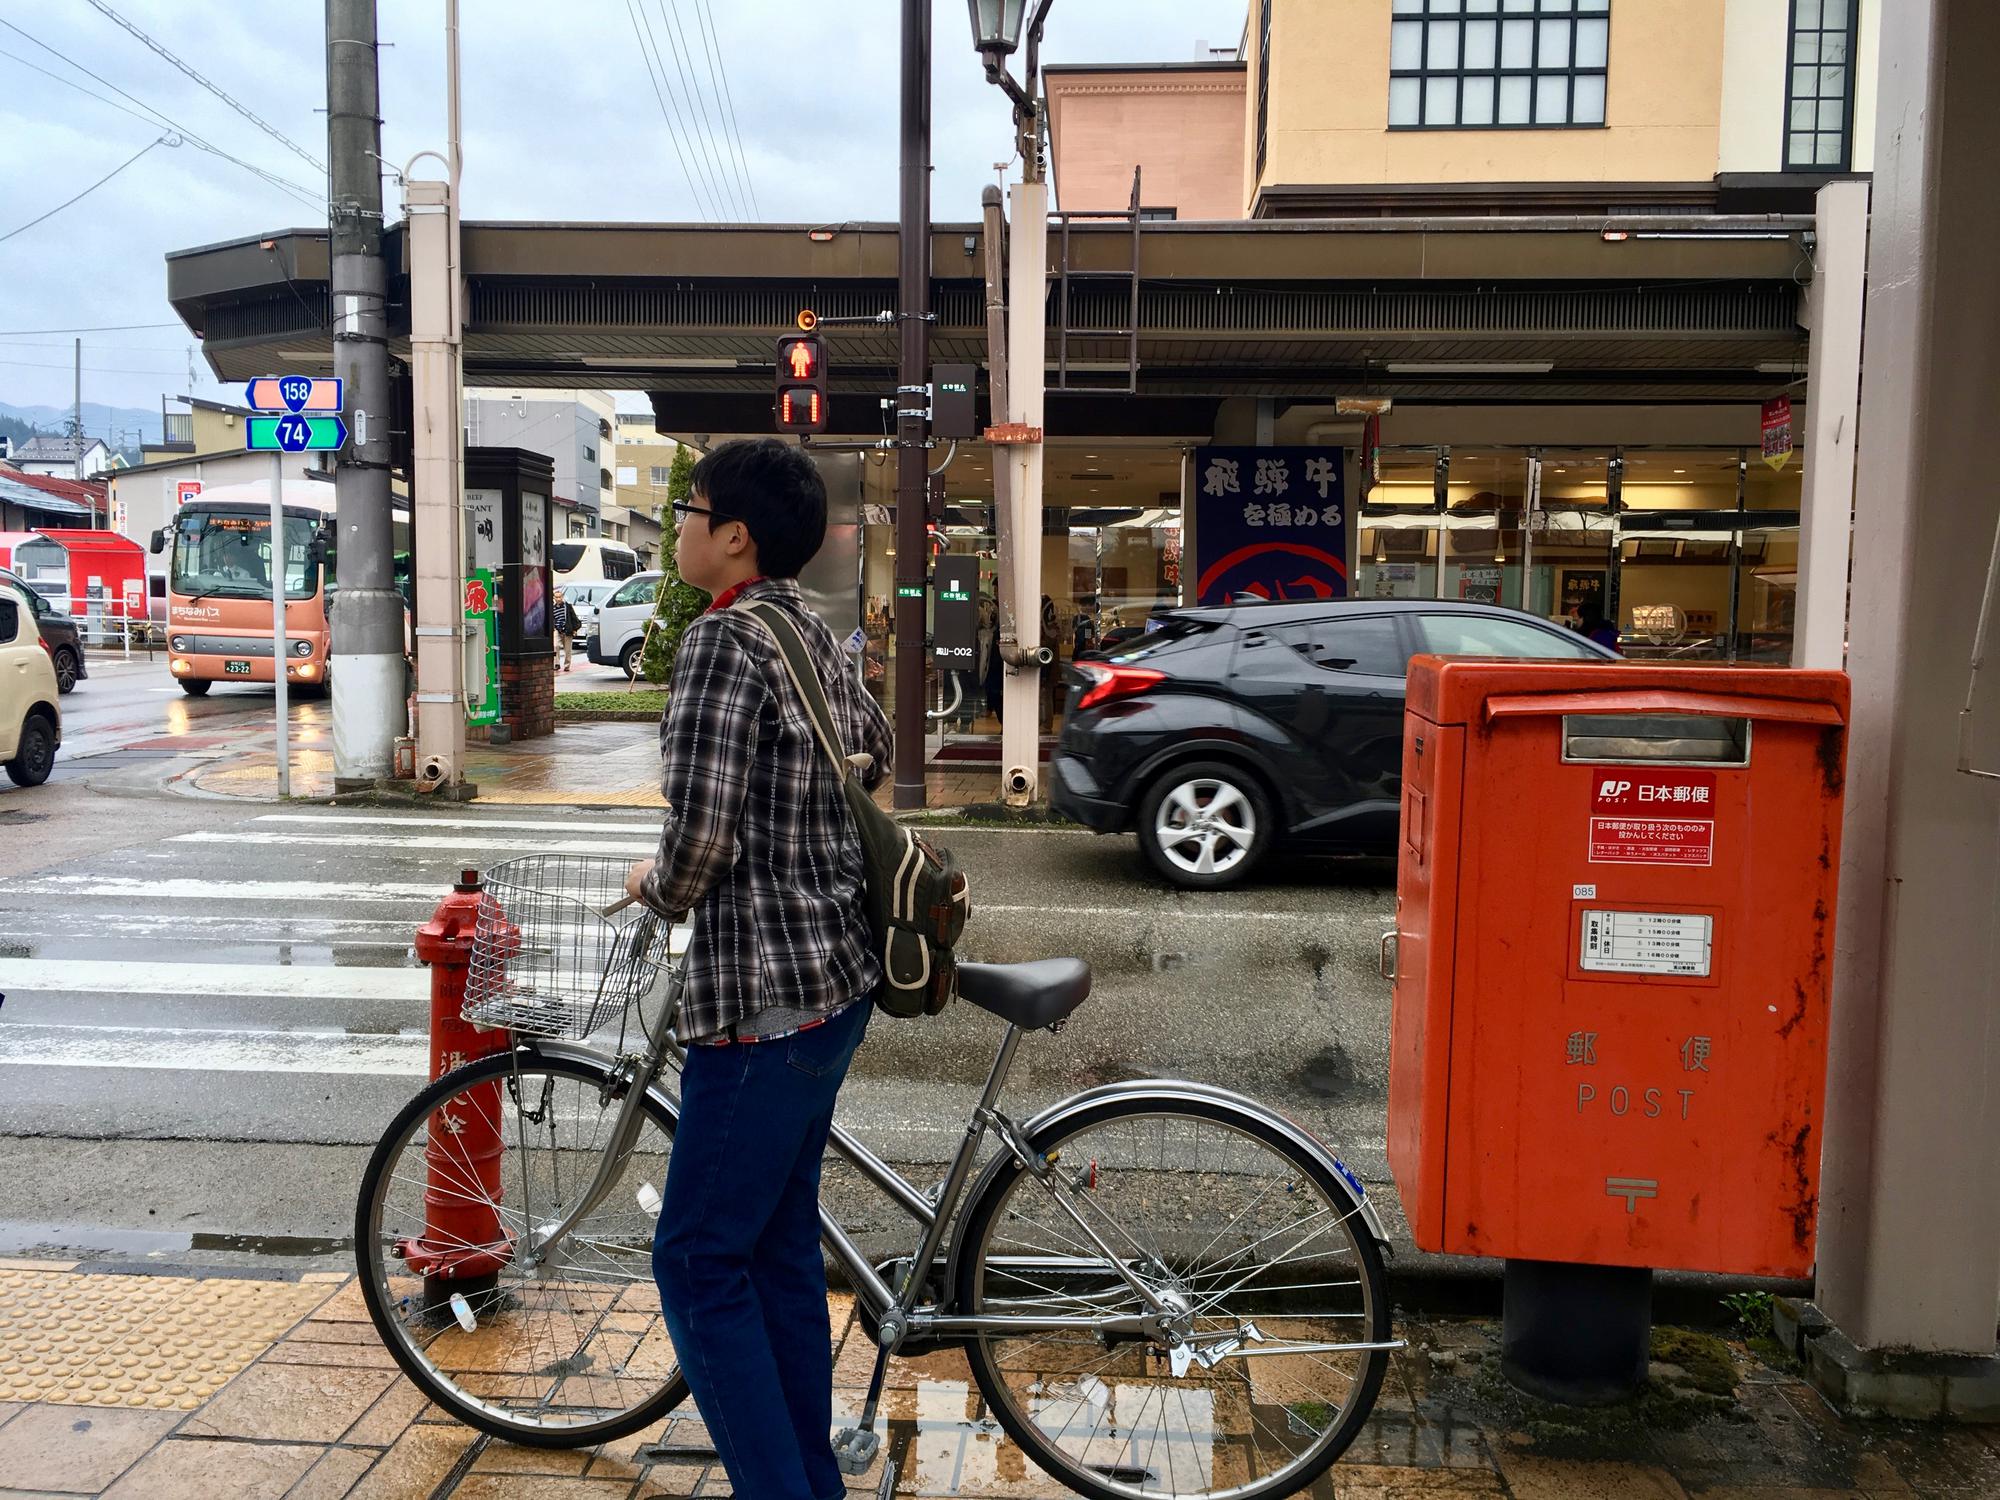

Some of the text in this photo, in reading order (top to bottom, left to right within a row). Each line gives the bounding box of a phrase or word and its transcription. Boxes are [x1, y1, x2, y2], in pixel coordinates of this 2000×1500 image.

[284, 383, 308, 400] 158
[282, 423, 304, 444] 74
[1204, 457, 1337, 498] 飛騨牛
[1244, 503, 1342, 527] を極める
[172, 606, 220, 617] まちなみバス
[936, 647, 973, 656] 高山-002
[1638, 785, 1709, 803] 日本郵便
[1597, 822, 1706, 833] 日本郵便が取り扱う次のもののみ
[1618, 831, 1684, 840] 投かんしてください
[1575, 887, 1594, 896] 085
[1590, 920, 1598, 950] 取集時刻
[1603, 940, 1610, 954] 休日
[1577, 1083, 1695, 1120] POST
